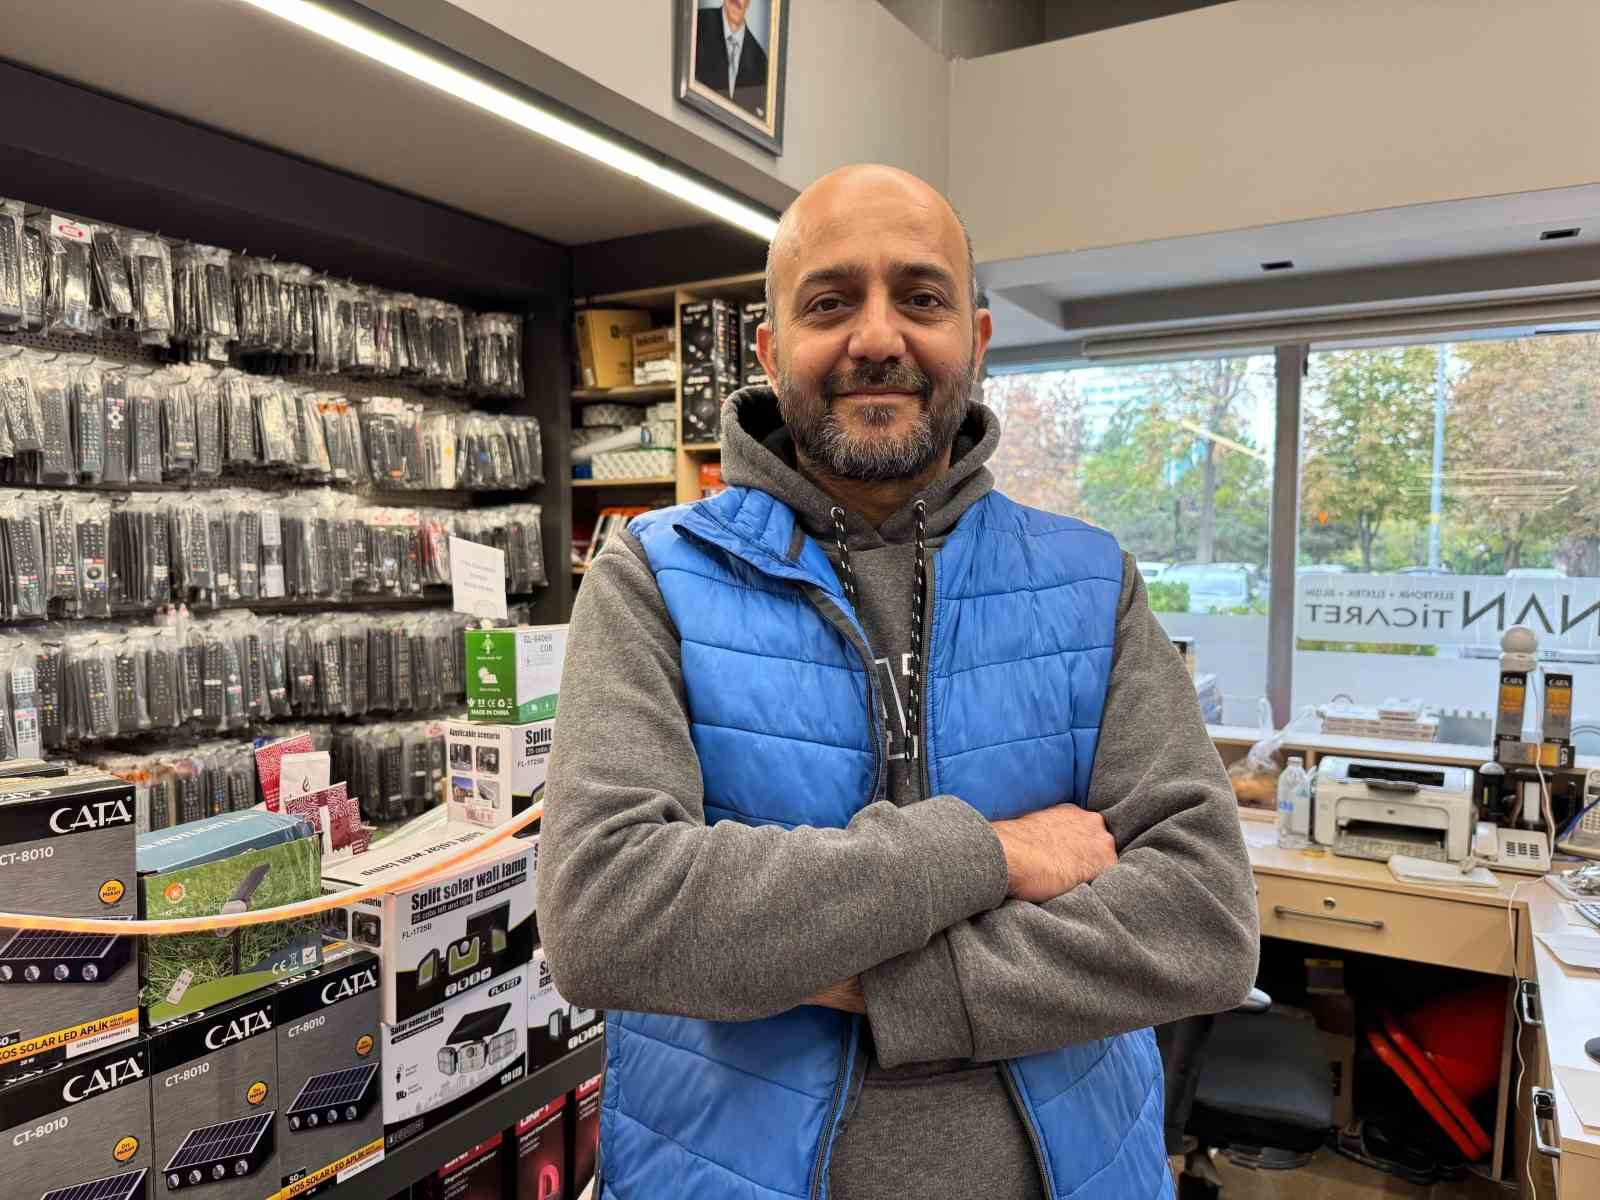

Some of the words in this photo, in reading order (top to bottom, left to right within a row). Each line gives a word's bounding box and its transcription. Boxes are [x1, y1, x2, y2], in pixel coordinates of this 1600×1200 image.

[493, 709, 510, 717] CHINA
[525, 728, 552, 745] Split
[49, 800, 132, 834] CATA
[0, 846, 54, 866] CT-8010
[411, 887, 442, 911] Split
[443, 876, 475, 900] solar
[476, 865, 500, 888] wall
[501, 856, 527, 877] lamp
[321, 970, 377, 1005] CATA
[205, 1009, 273, 1050] CATA
[287, 1015, 326, 1038] CT-8010
[20, 1037, 55, 1053] SOLAR
[58, 1029, 78, 1043] LED
[62, 1057, 144, 1102] CATA
[165, 1062, 210, 1088] CT-8010
[13, 1117, 69, 1146] CT-8010
[305, 1169, 330, 1188] SOLAR
[331, 1161, 345, 1176] LED
